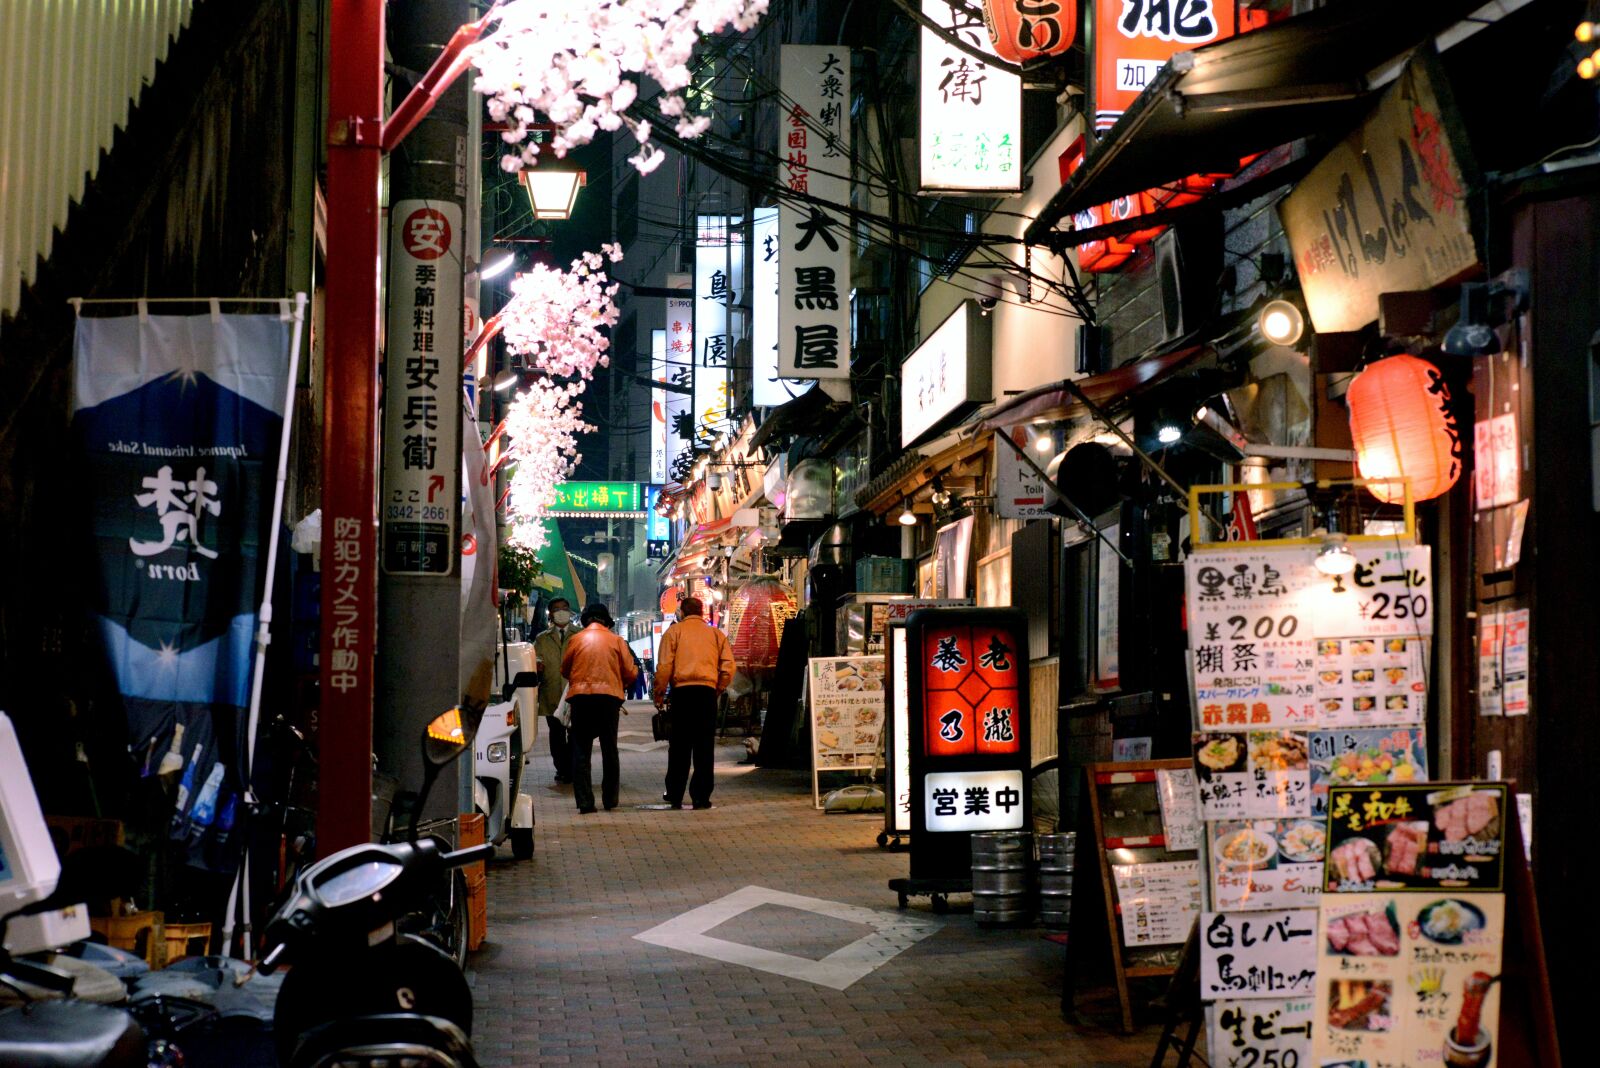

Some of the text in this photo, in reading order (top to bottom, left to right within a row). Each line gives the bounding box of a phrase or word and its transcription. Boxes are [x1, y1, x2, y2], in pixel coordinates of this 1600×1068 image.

[409, 216, 443, 252] 安
[793, 207, 840, 370] 大黒屋
[413, 264, 439, 353] 季節料理
[402, 357, 440, 471] 安兵衛
[393, 489, 420, 503] ここ
[386, 505, 450, 521] 3342-2661
[1197, 563, 1288, 602] 黒霧島
[331, 516, 363, 694] 防犯カメラ作動中
[1358, 592, 1428, 620] ¥250
[1204, 614, 1298, 642] ¥200
[1202, 701, 1272, 726] 赤霧島
[932, 786, 1020, 818] 営業中
[1285, 1001, 1312, 1013] Beer
